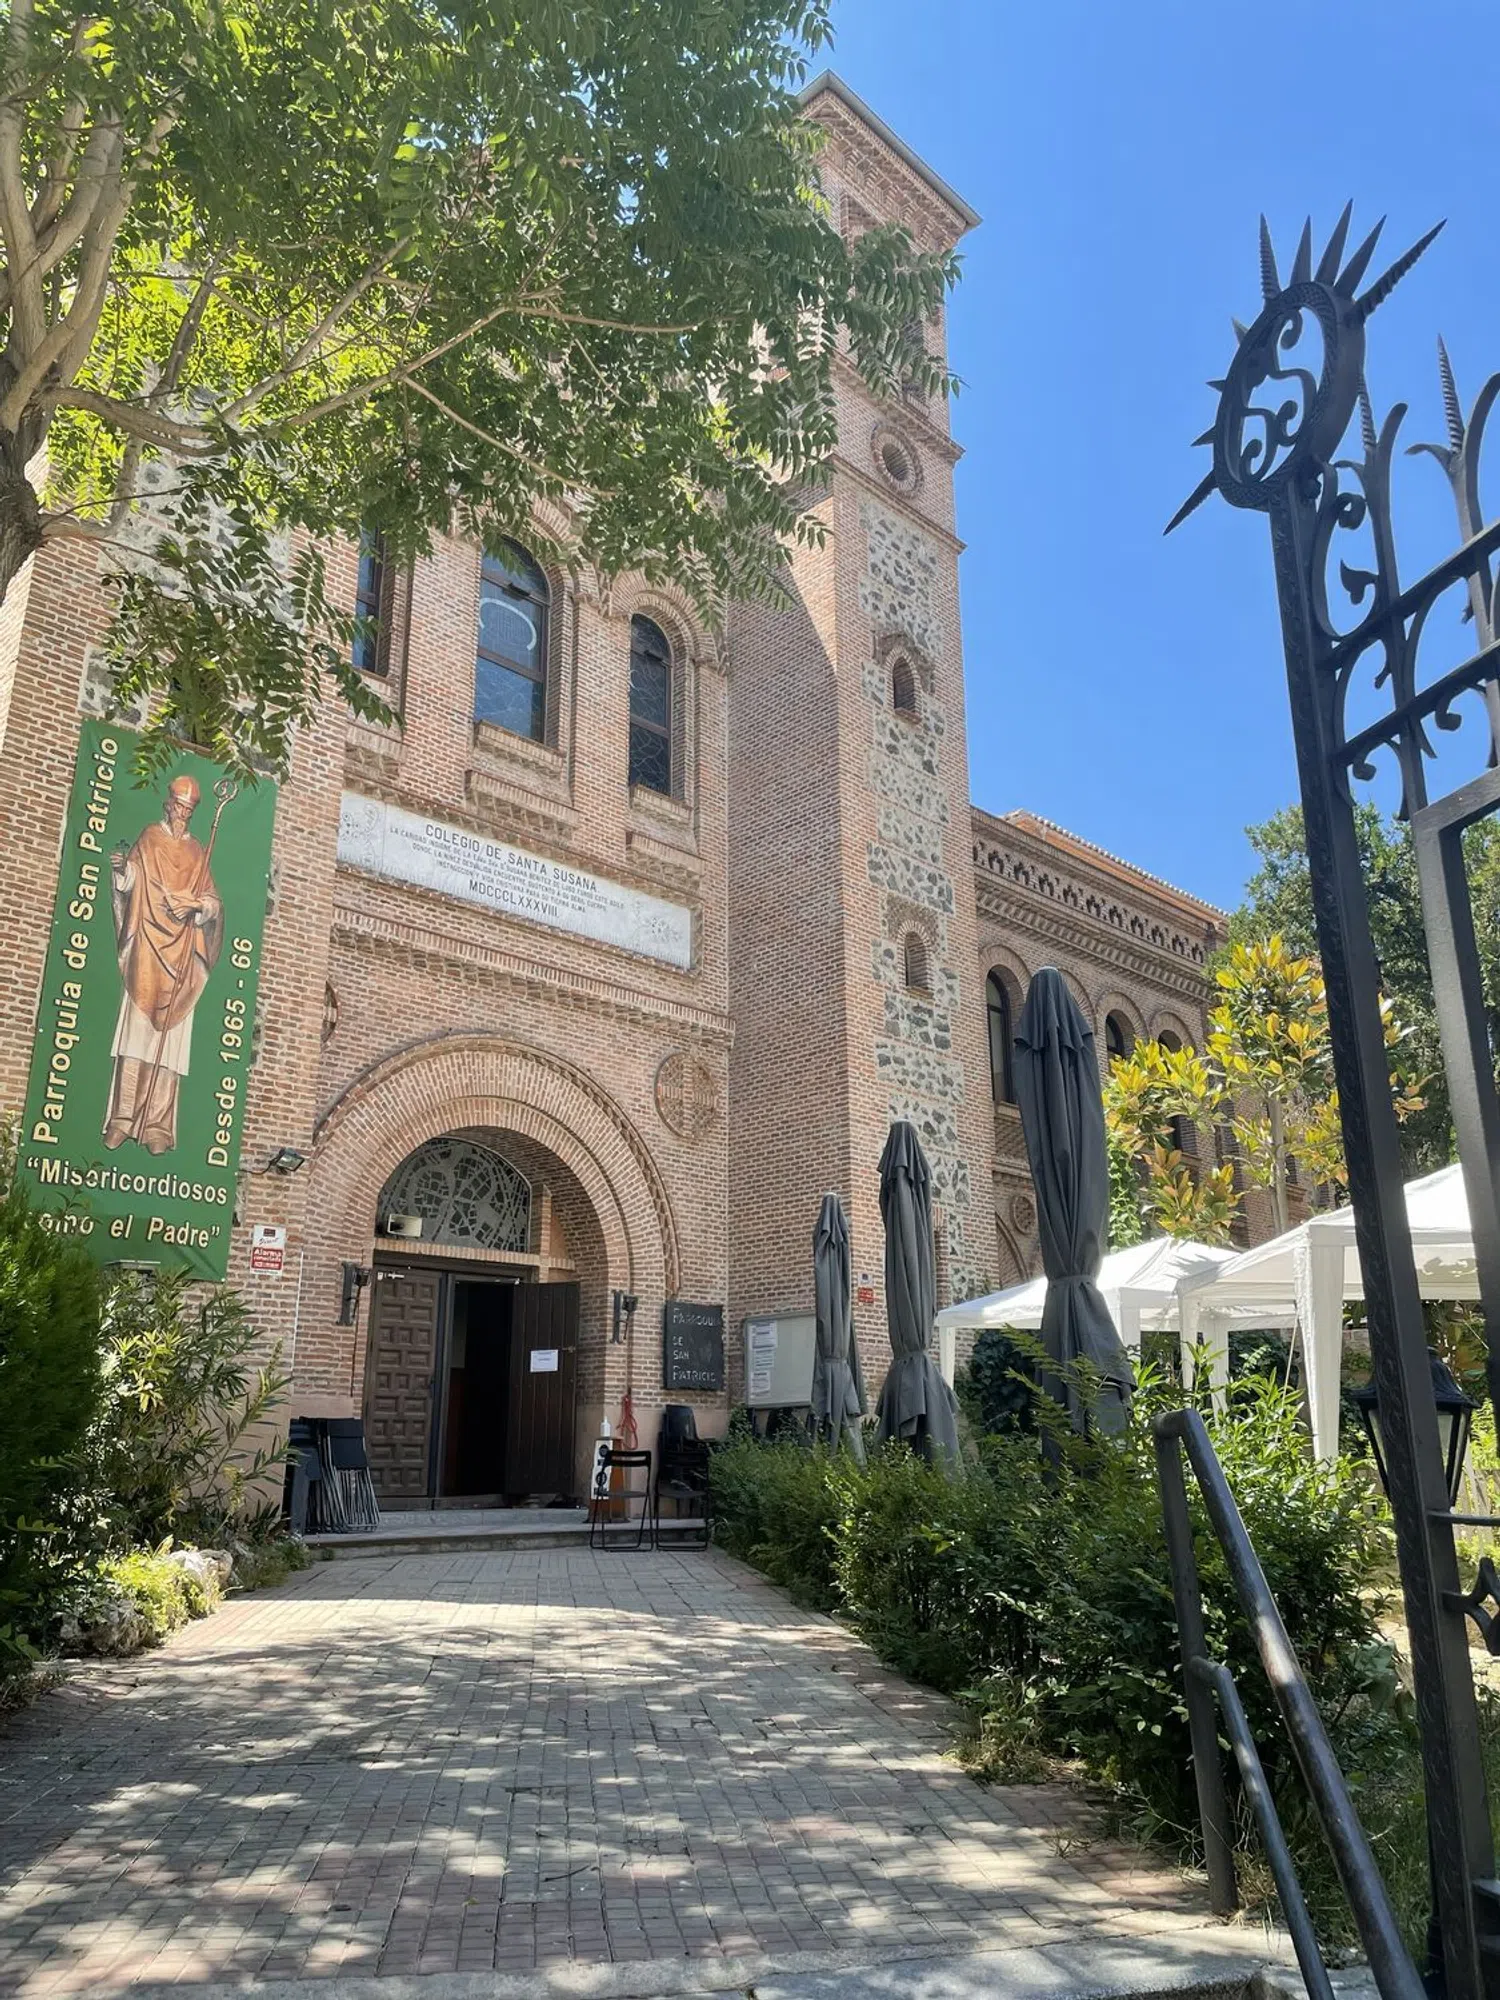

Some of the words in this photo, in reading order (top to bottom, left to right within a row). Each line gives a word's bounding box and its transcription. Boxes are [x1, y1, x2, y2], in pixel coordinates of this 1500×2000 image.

[80, 738, 118, 853] Patricio
[426, 824, 479, 852] COLEGIO
[487, 844, 500, 859] DE
[508, 852, 546, 875] SANTA
[69, 863, 100, 921] San
[63, 932, 89, 970] de
[231, 937, 253, 969] 66
[219, 998, 246, 1063] 1965
[33, 981, 82, 1143] Parroquia
[207, 1076, 237, 1167] Desde
[110, 1214, 133, 1239] el
[673, 1350, 690, 1360] SAN
